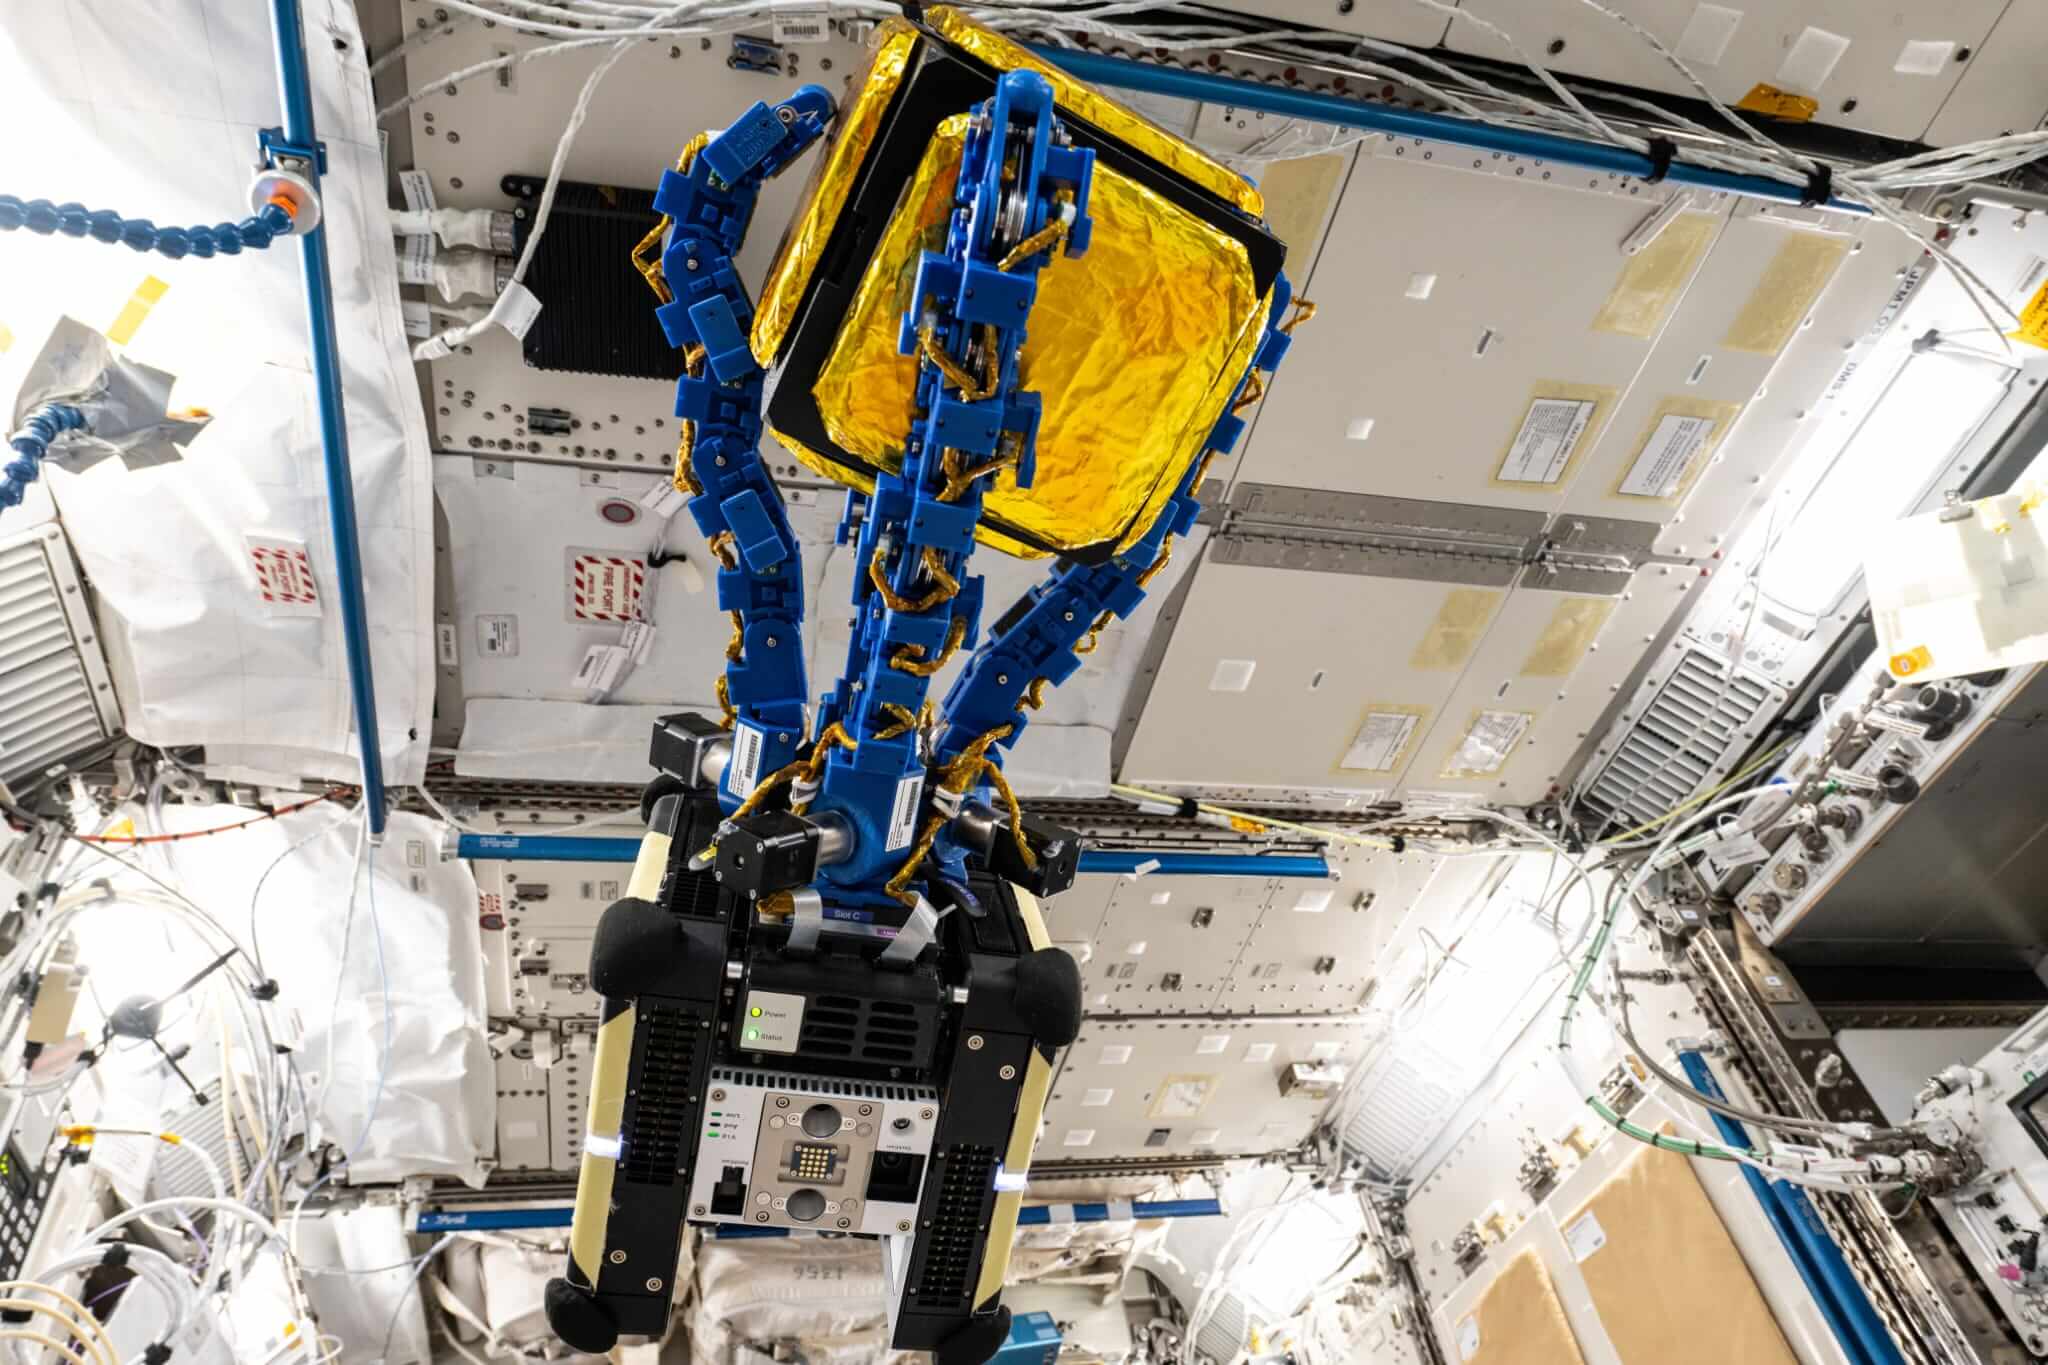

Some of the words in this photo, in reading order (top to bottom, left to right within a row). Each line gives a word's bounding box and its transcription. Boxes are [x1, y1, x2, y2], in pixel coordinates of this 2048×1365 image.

[1888, 271, 1919, 309] JPM1
[603, 566, 613, 586] FIRE
[603, 588, 613, 612] PORT
[834, 910, 851, 919] Slot
[852, 911, 861, 920] C
[764, 1010, 786, 1019] Power
[761, 1033, 782, 1041] Status
